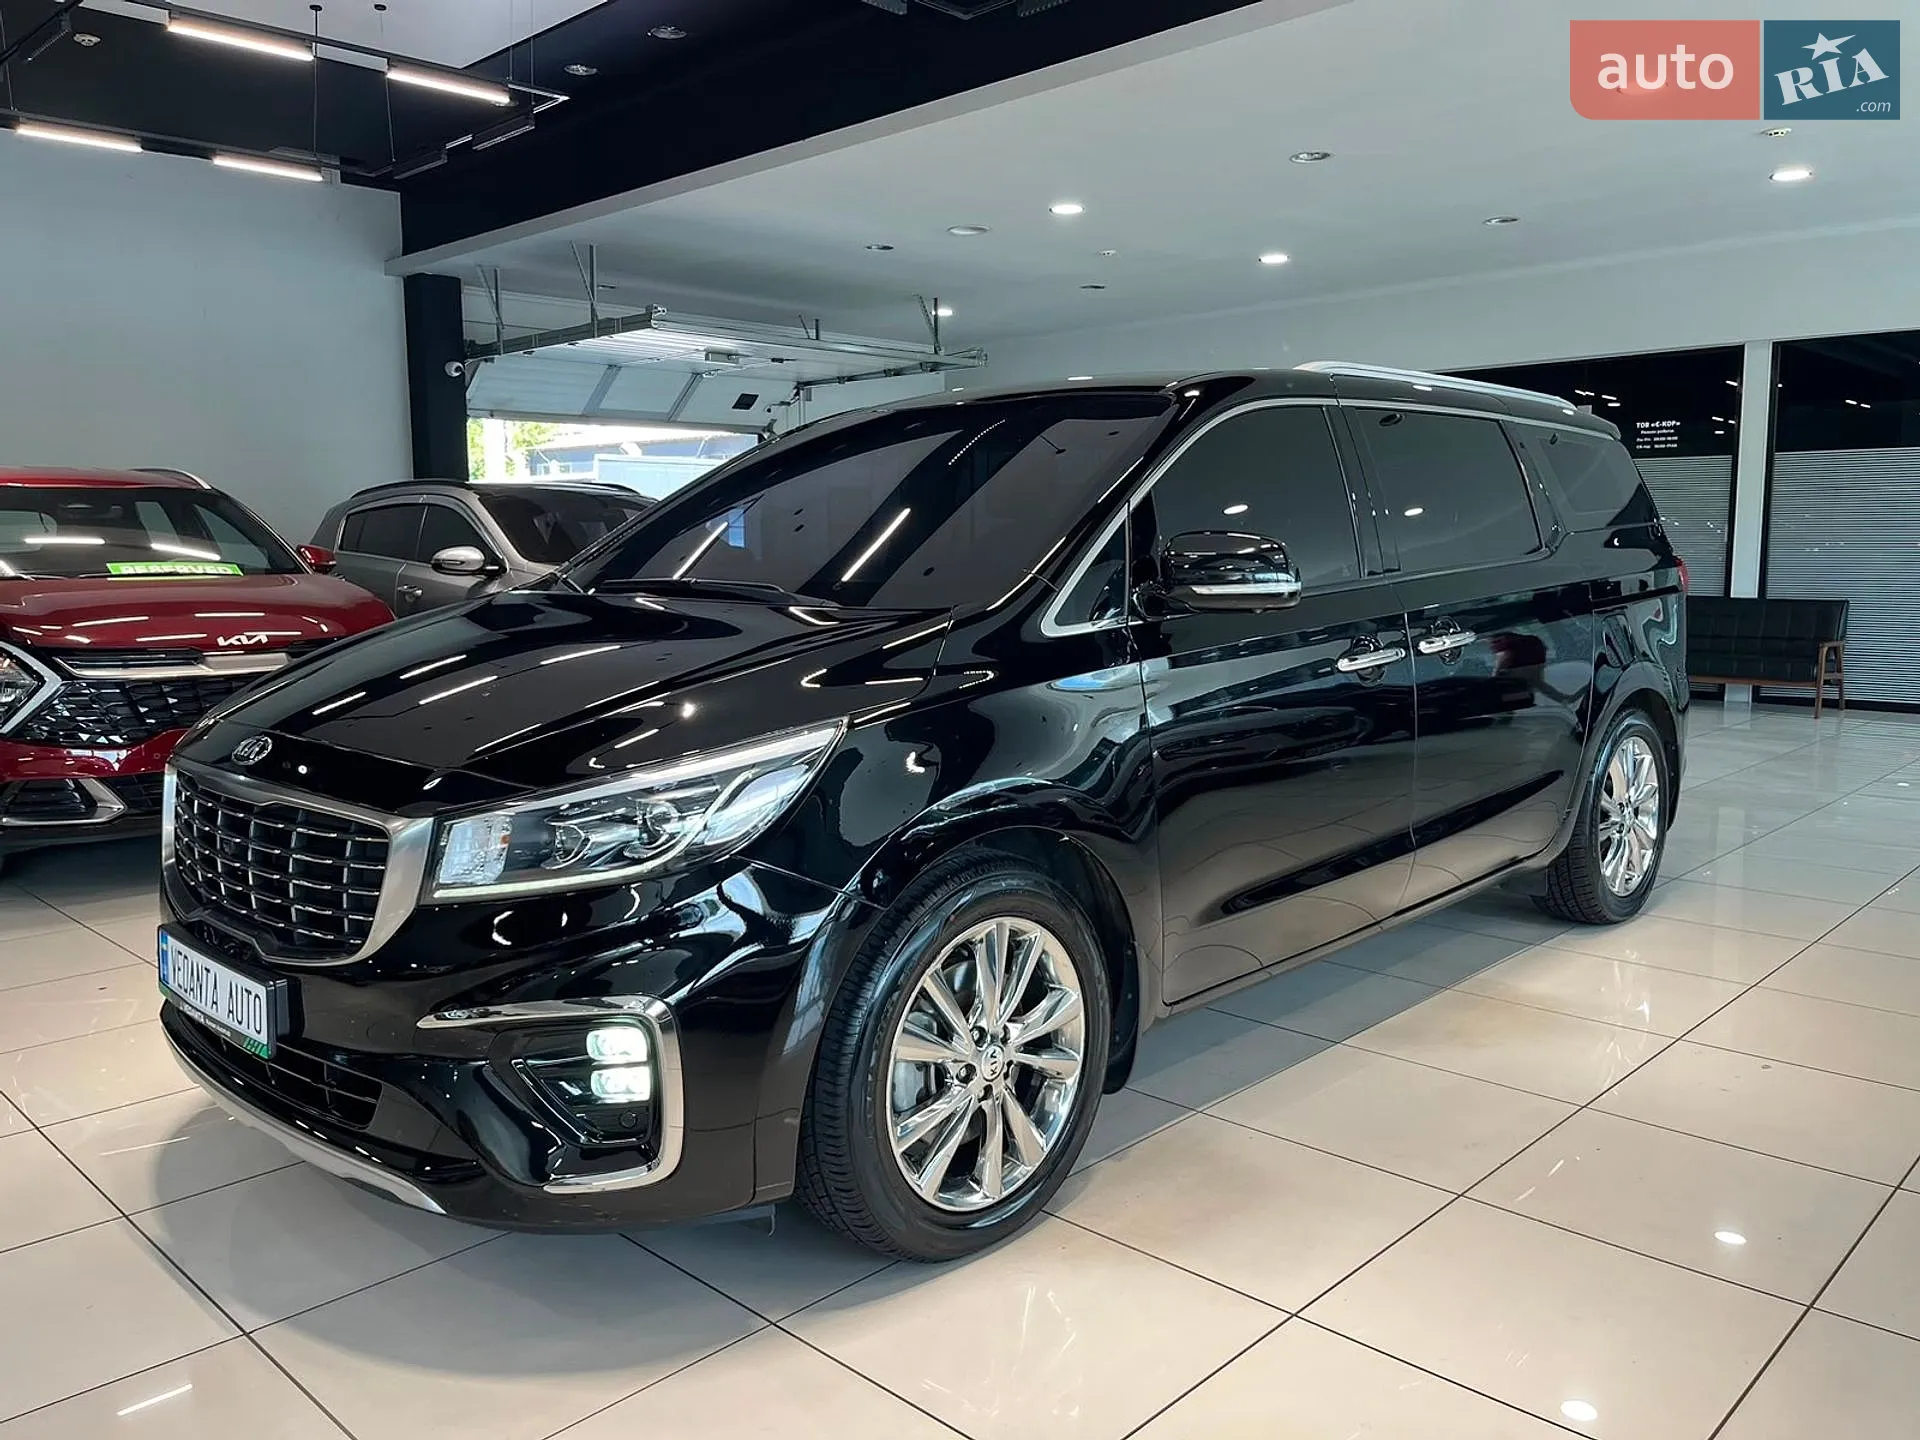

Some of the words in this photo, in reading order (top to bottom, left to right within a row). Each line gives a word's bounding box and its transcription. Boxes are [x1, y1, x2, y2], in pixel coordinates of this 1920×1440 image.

[121, 565, 232, 575] RESERVED
[217, 634, 268, 647] KIA
[170, 945, 219, 1013] VEDANTA
[227, 980, 262, 1036] AUTO
